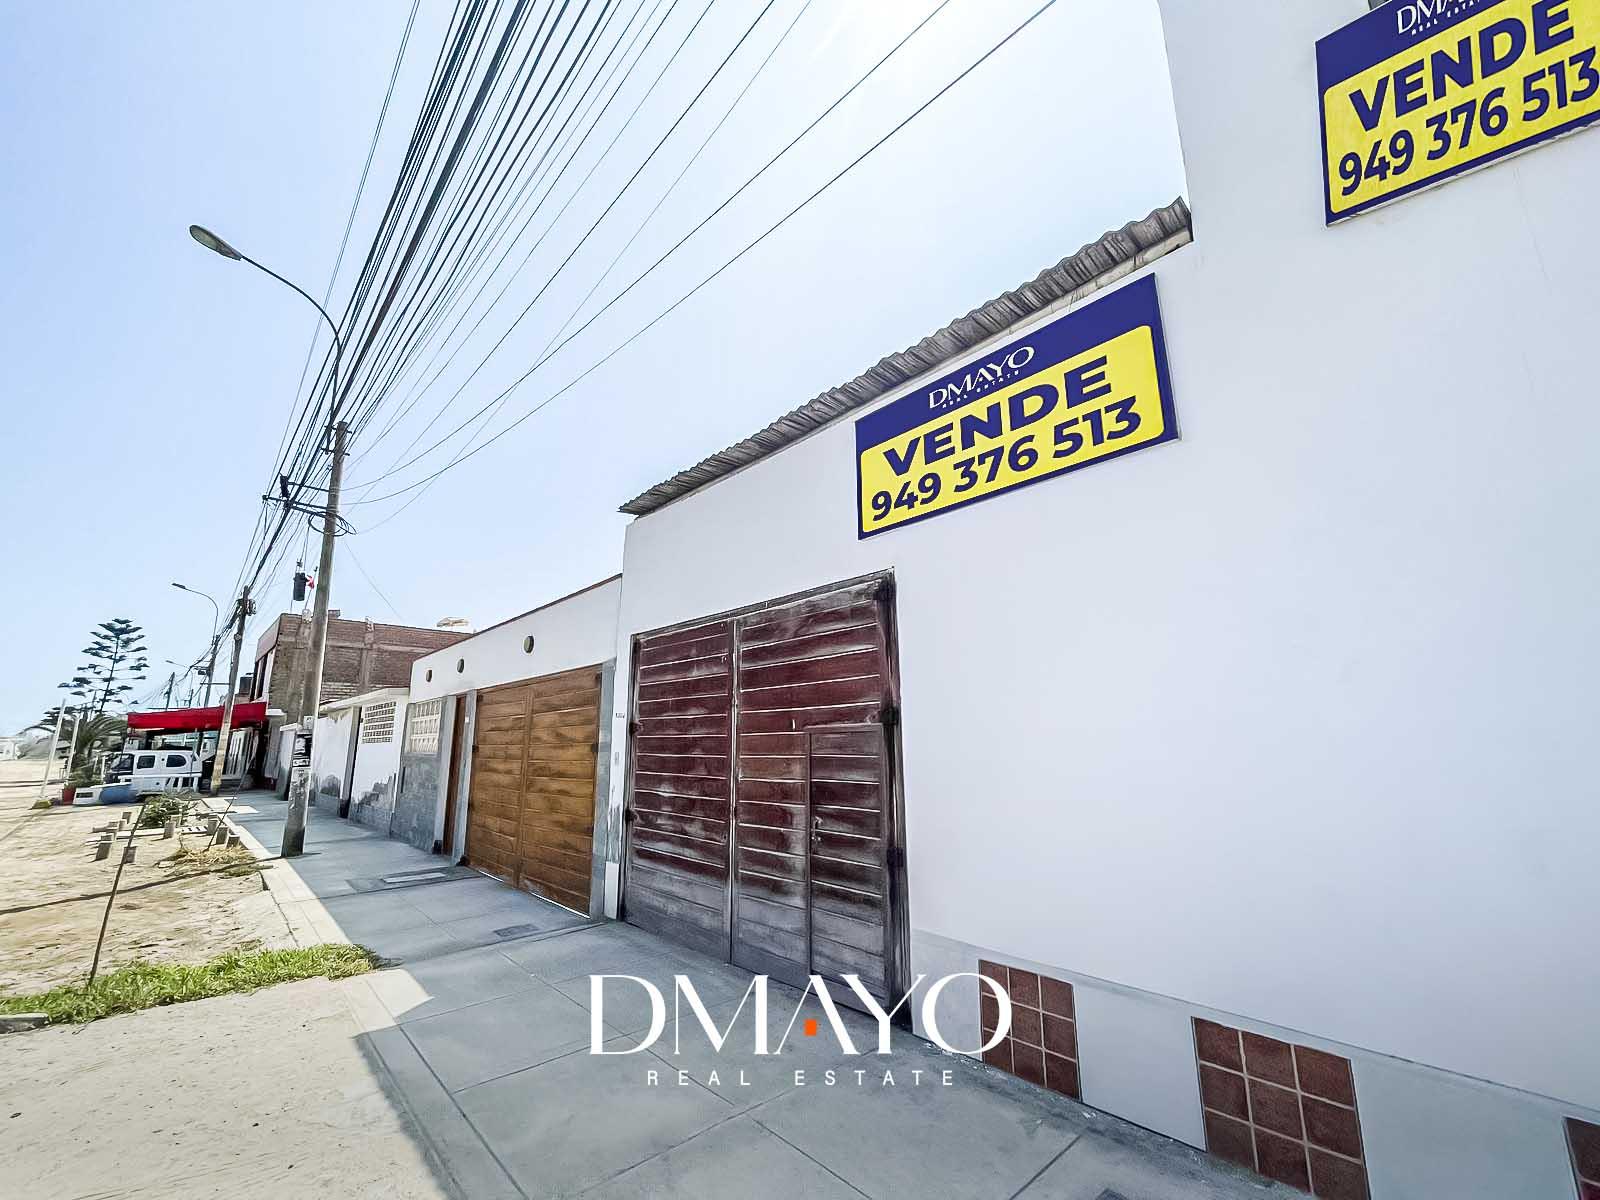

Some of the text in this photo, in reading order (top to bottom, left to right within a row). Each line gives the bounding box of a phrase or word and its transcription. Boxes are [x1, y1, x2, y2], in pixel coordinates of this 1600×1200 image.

[1338, 46, 1600, 196] 949 376 513
[1348, 0, 1574, 132] VENDE
[883, 355, 1112, 477] VENDE
[928, 346, 1035, 409] DMAYO
[871, 395, 1142, 521] 949 376 513
